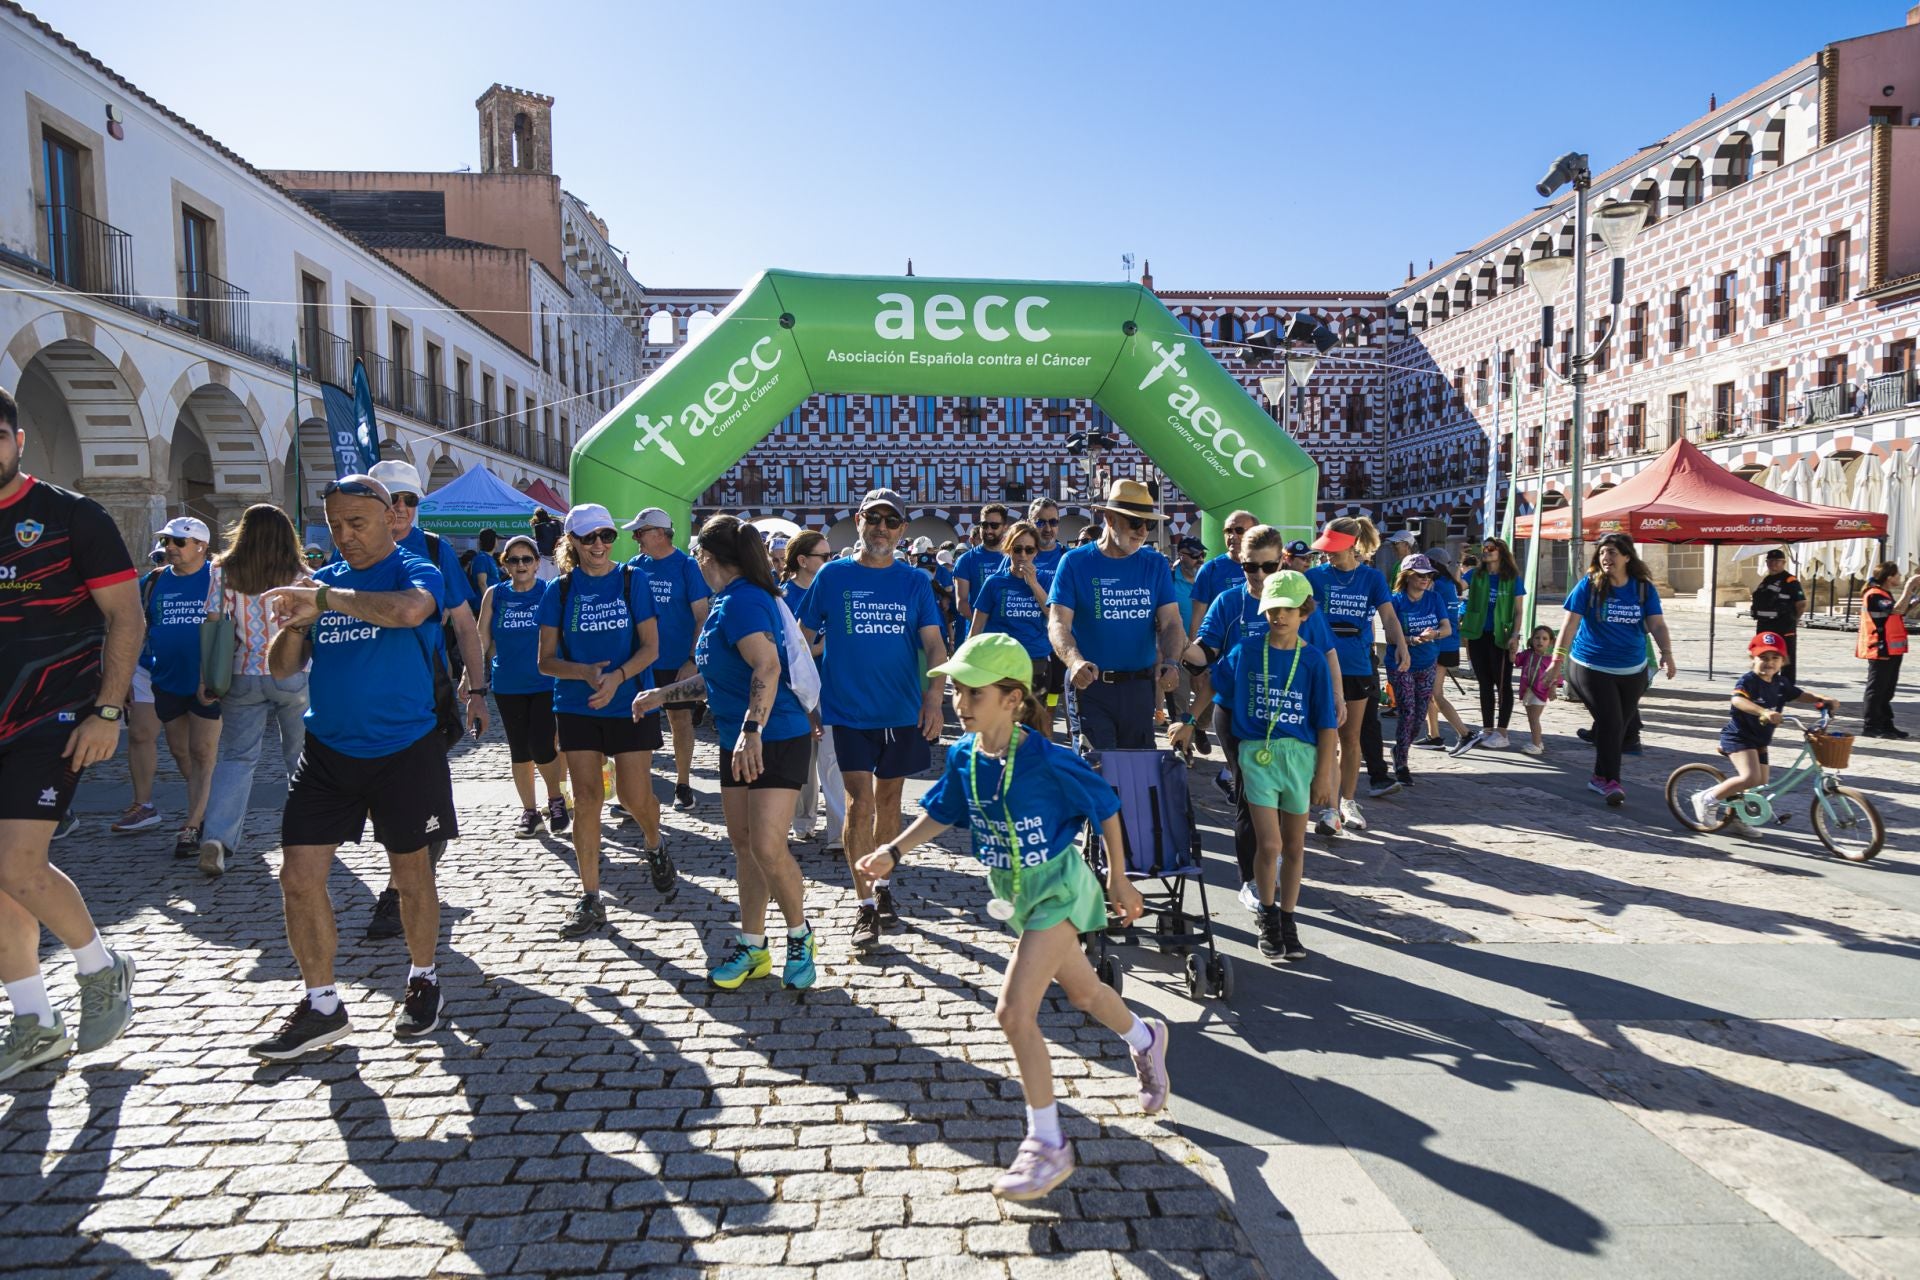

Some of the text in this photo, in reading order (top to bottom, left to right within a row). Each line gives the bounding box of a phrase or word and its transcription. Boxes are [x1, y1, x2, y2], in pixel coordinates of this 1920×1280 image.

[874, 292, 1052, 343] aecc
[827, 349, 1092, 367] Asociación Española contra el Cáncer
[680, 335, 782, 437] aecc
[712, 374, 780, 437] Contra el Cáncer
[1168, 384, 1266, 478] aecc
[1168, 415, 1231, 478] Contra el Cáncer
[663, 586, 671, 594] el
[1102, 587, 1150, 596] En marcha
[582, 603, 593, 611] En
[595, 598, 626, 611] marcha
[654, 595, 671, 603] cer
[1103, 596, 1151, 606] contra el
[1330, 599, 1357, 607] contra
[164, 607, 195, 615] contra
[853, 601, 907, 611] En marcha
[1330, 607, 1366, 617] cáncer
[581, 607, 627, 620] contra el
[854, 611, 906, 622] contra el
[1006, 608, 1042, 617] cáncer
[1103, 607, 1151, 619] cáncer
[162, 615, 207, 625] cáncer
[580, 618, 628, 632] cáncer
[1607, 616, 1640, 624] cáncer
[855, 620, 905, 634] cáncer
[319, 626, 380, 644] cáncer
[700, 637, 709, 649] el
[988, 816, 1043, 832] macha
[1027, 827, 1047, 845] el
